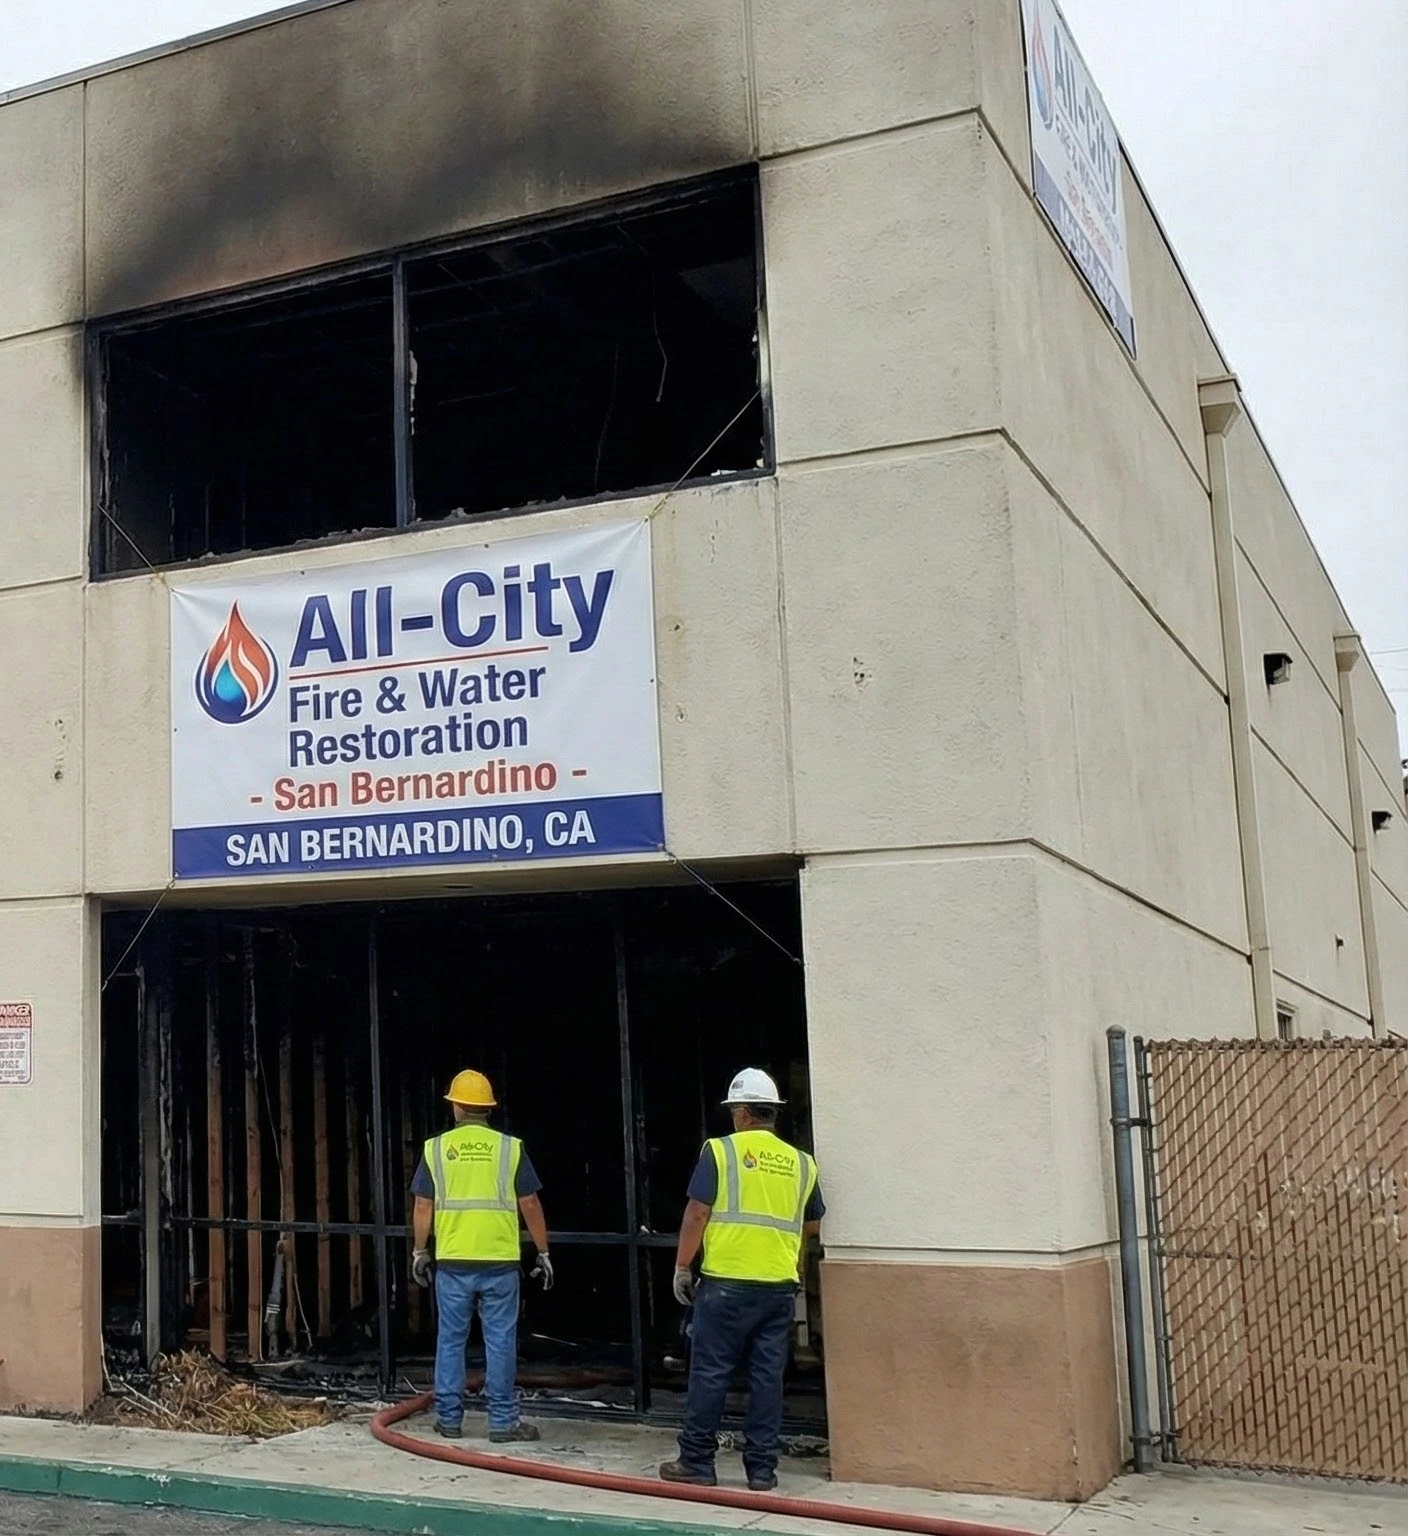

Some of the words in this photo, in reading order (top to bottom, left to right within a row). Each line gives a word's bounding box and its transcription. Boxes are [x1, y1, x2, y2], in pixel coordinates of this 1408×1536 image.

[289, 562, 615, 668] All-City
[289, 683, 363, 723] Fire
[376, 676, 406, 714] &
[418, 665, 547, 709] Water
[289, 714, 528, 768] Restoration
[274, 775, 338, 811] San
[351, 760, 558, 806] Bernardino
[226, 828, 290, 867] SAN
[300, 814, 534, 862] BERNARDINO,
[545, 809, 596, 847] CA
